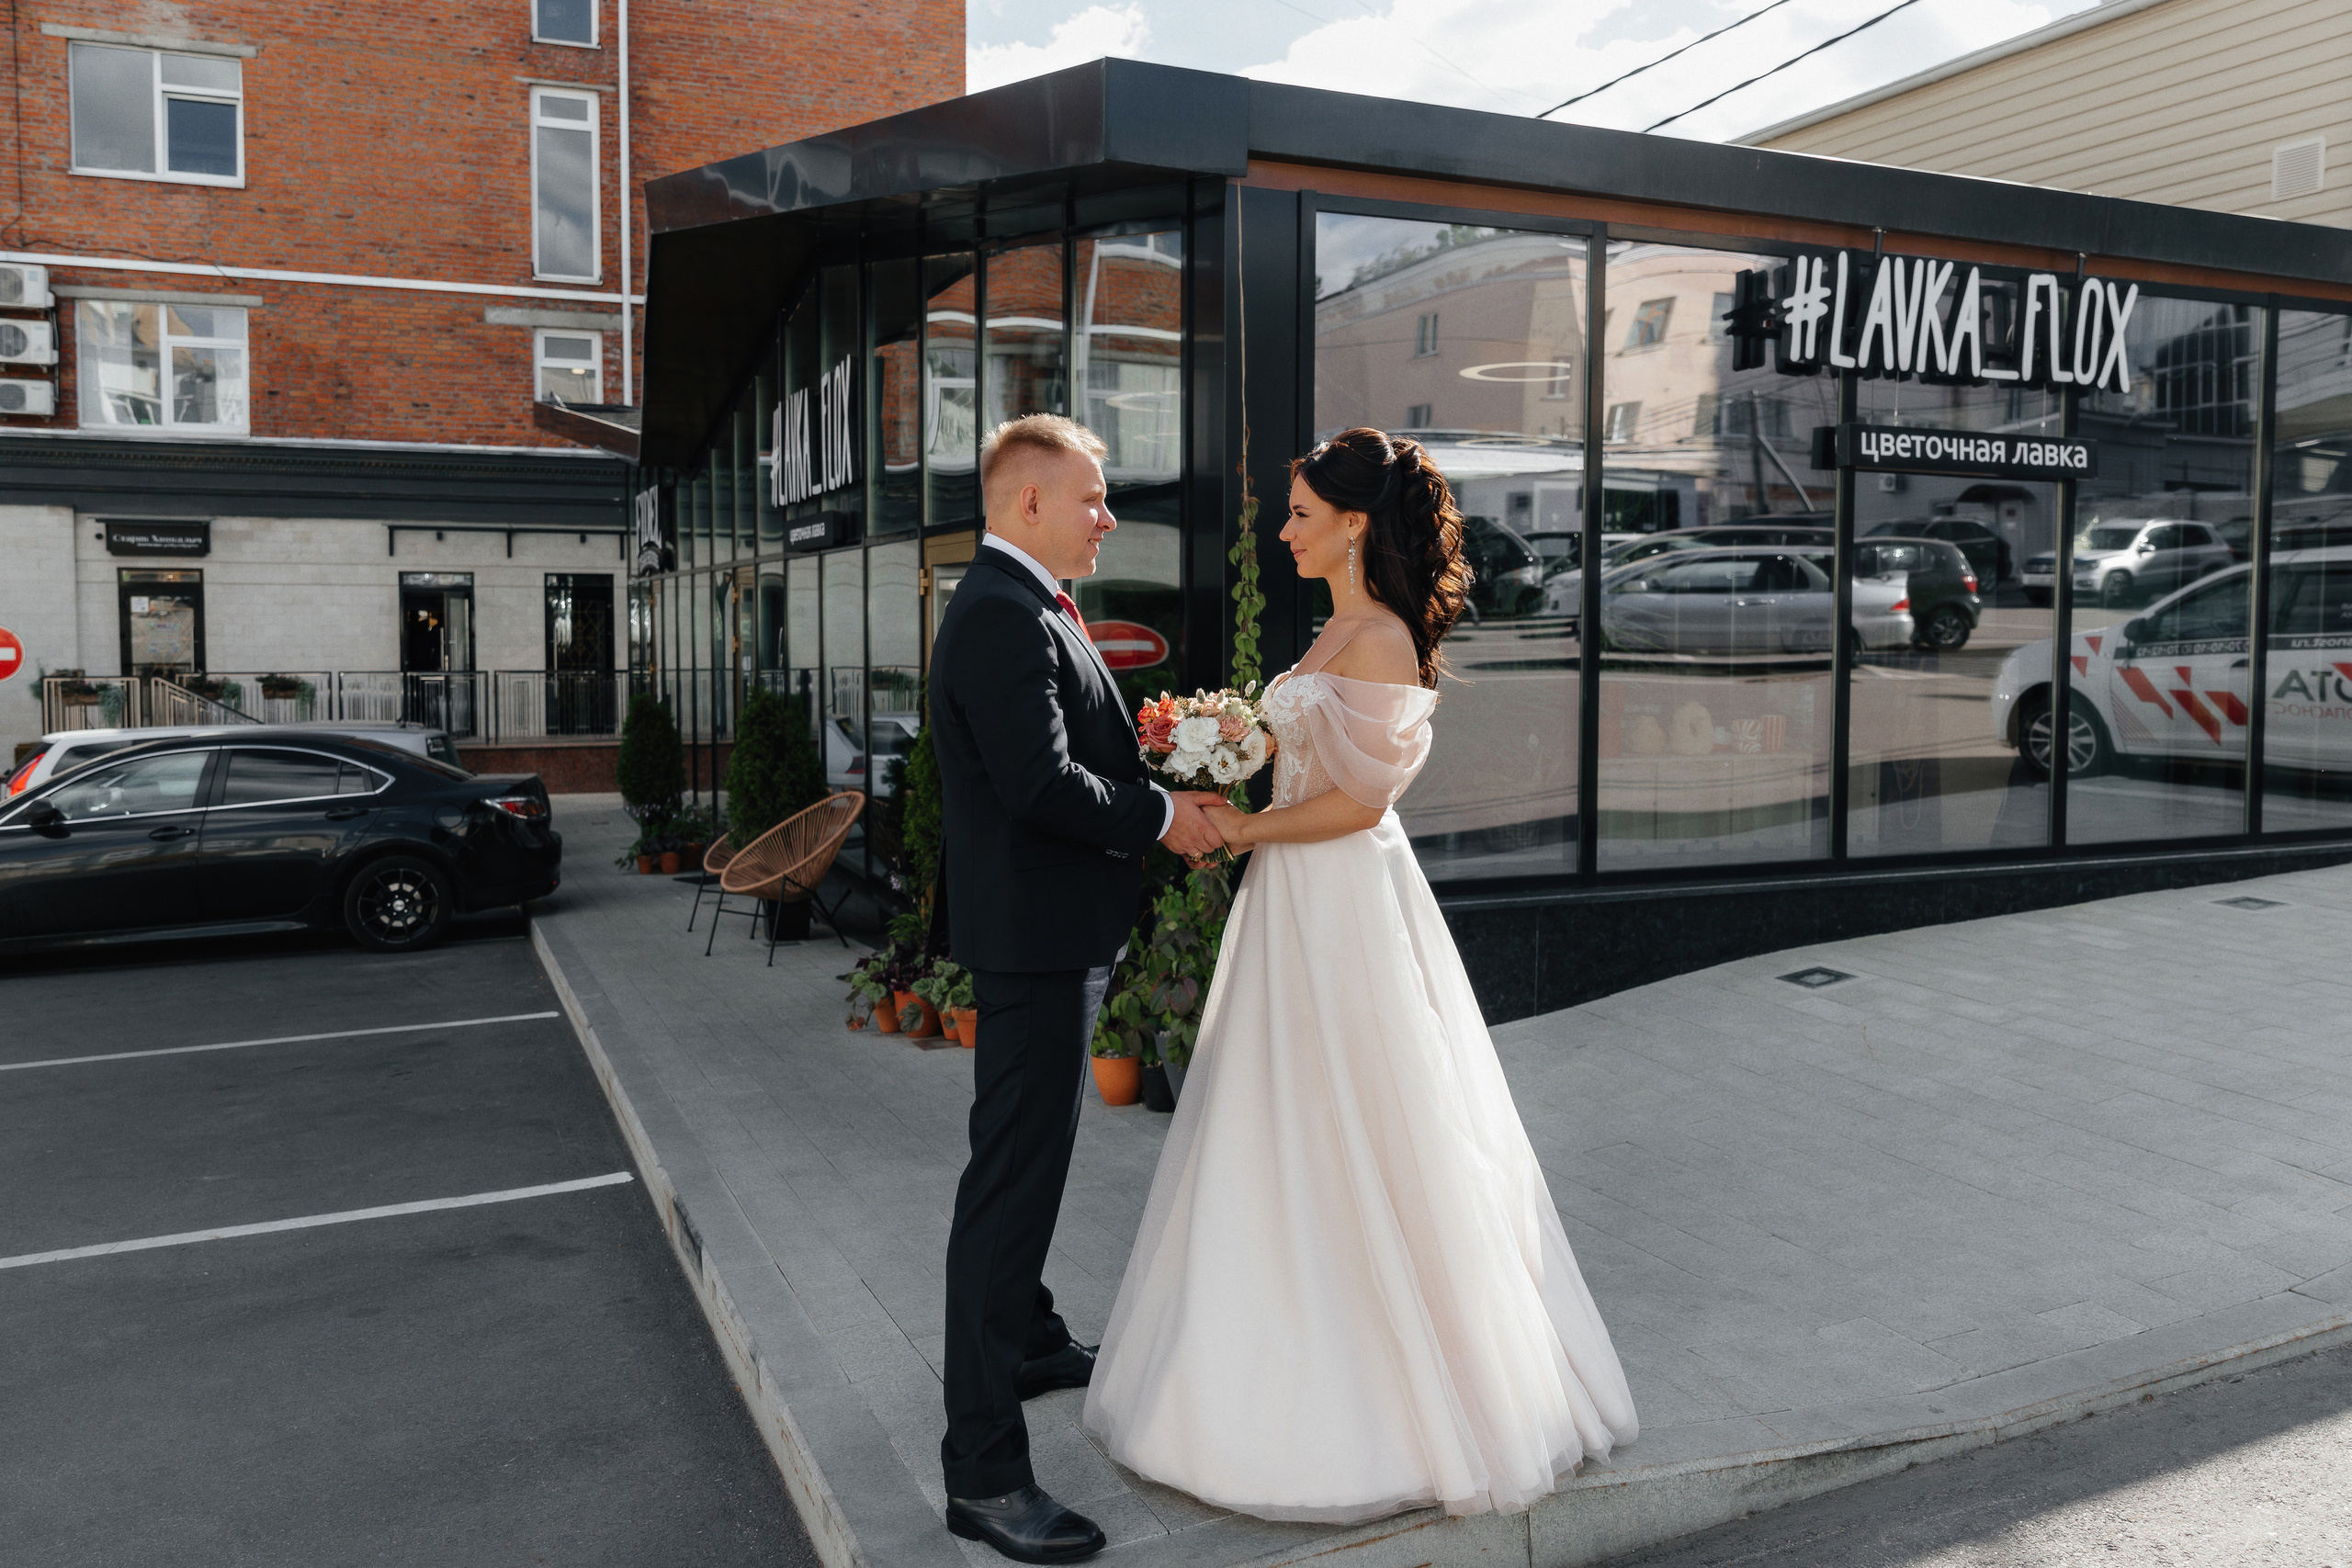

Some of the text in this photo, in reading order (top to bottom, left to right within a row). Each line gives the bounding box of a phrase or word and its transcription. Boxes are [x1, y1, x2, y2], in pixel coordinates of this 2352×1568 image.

[1781, 251, 2139, 394] #LAVKA_FLOX
[1860, 431, 2088, 469] цветочная лавка
